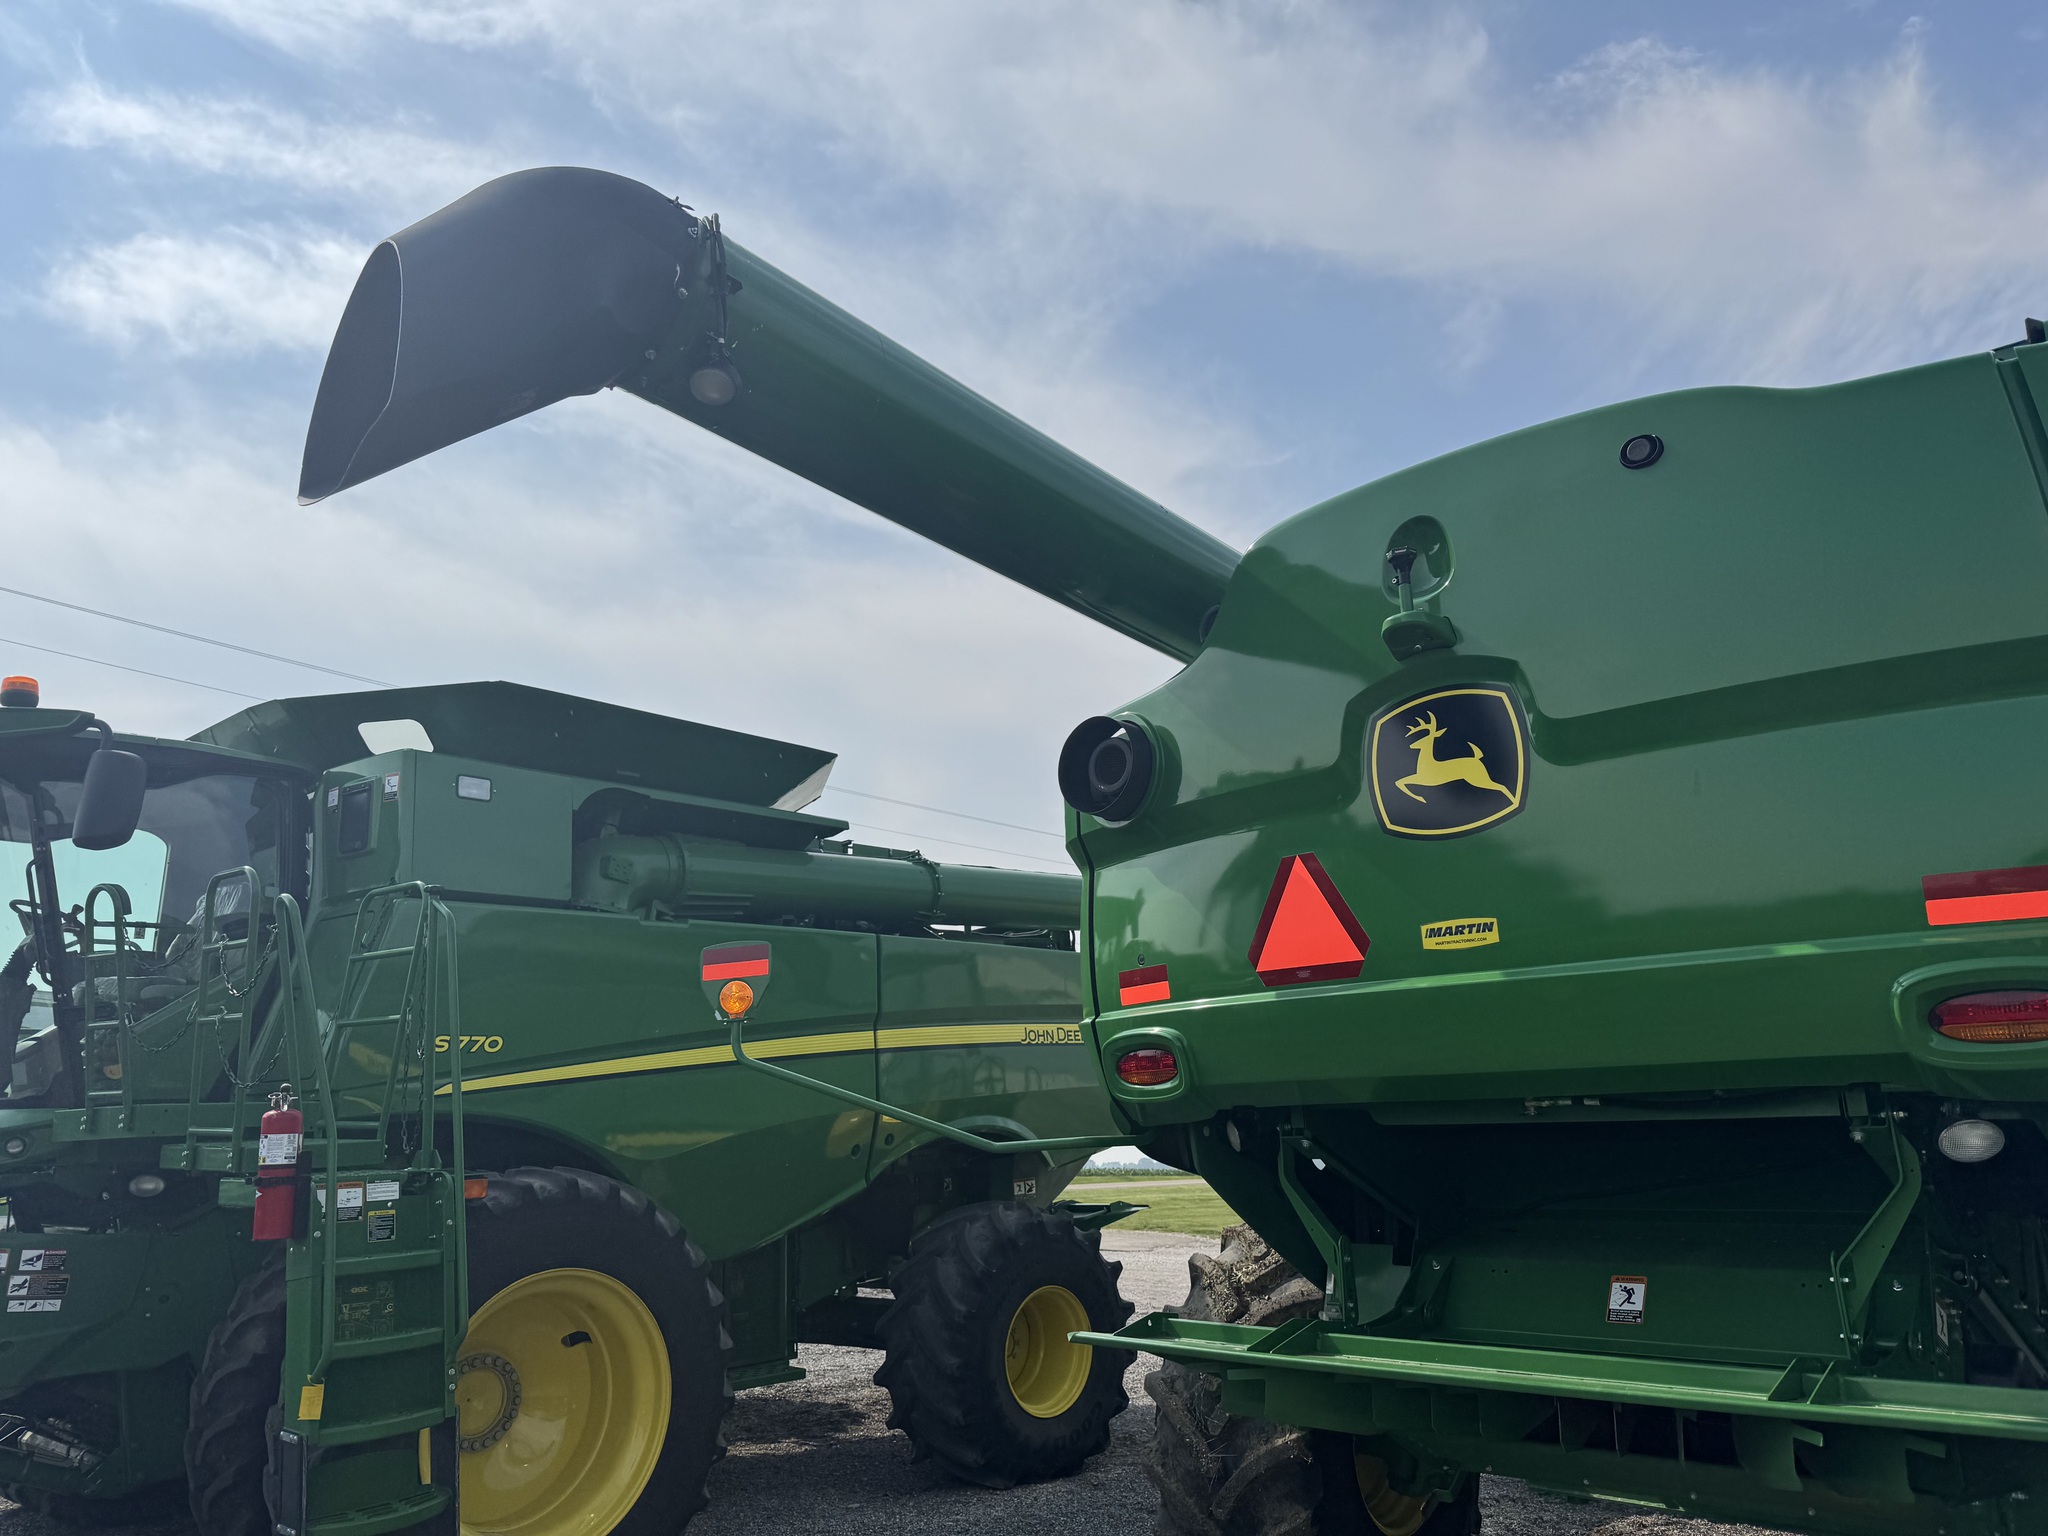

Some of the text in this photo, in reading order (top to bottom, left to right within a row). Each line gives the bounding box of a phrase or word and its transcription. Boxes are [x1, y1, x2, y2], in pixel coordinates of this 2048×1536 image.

[1425, 921, 1494, 939] MARTIN
[1021, 1027, 1084, 1042] JOHN DEE
